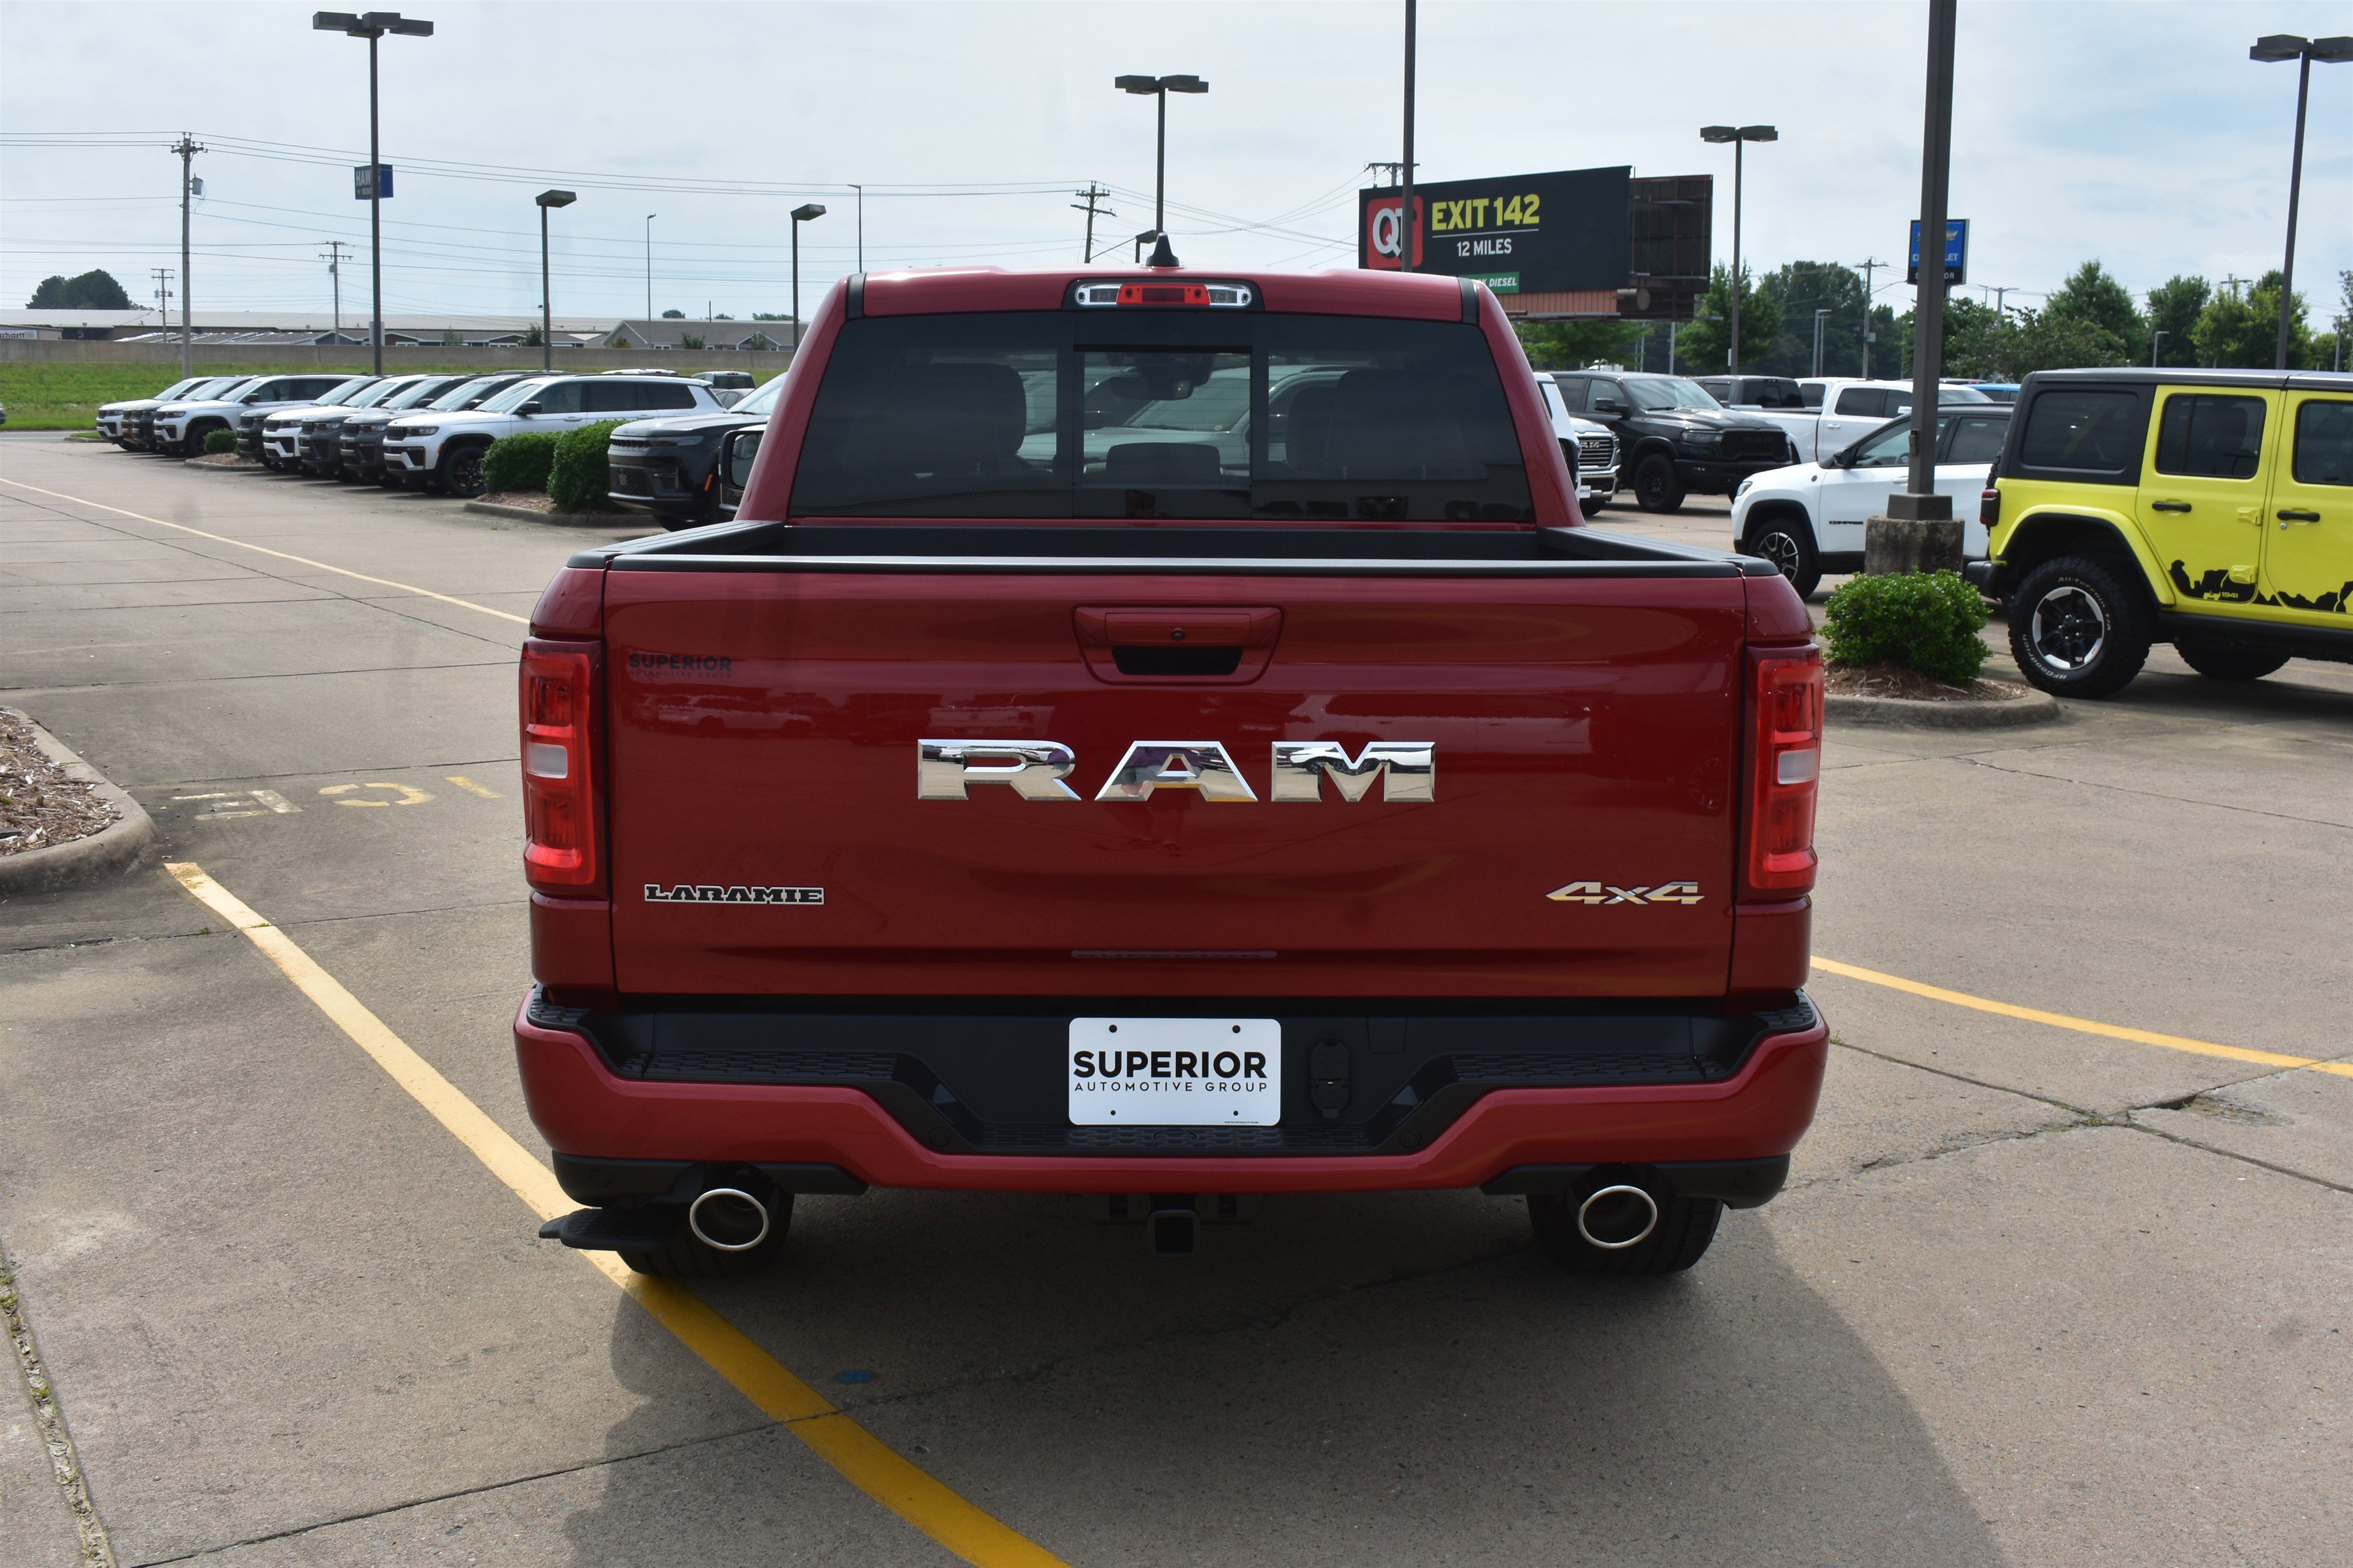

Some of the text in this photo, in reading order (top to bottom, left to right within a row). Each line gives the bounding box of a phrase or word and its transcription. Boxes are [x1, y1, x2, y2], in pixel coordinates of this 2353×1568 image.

[1432, 194, 1540, 230] EXIT 142
[1457, 238, 1512, 257] 12 MILES
[1488, 277, 1517, 287] DIESEL
[629, 653, 732, 671] SUPERIOR
[918, 739, 1435, 801] RAM
[644, 884, 825, 905] LARAMIE
[1546, 881, 1705, 904] 4x4
[1073, 1051, 1267, 1078] SUPERIOR
[1075, 1082, 1267, 1092] AUTOMOTIVE GROUP
